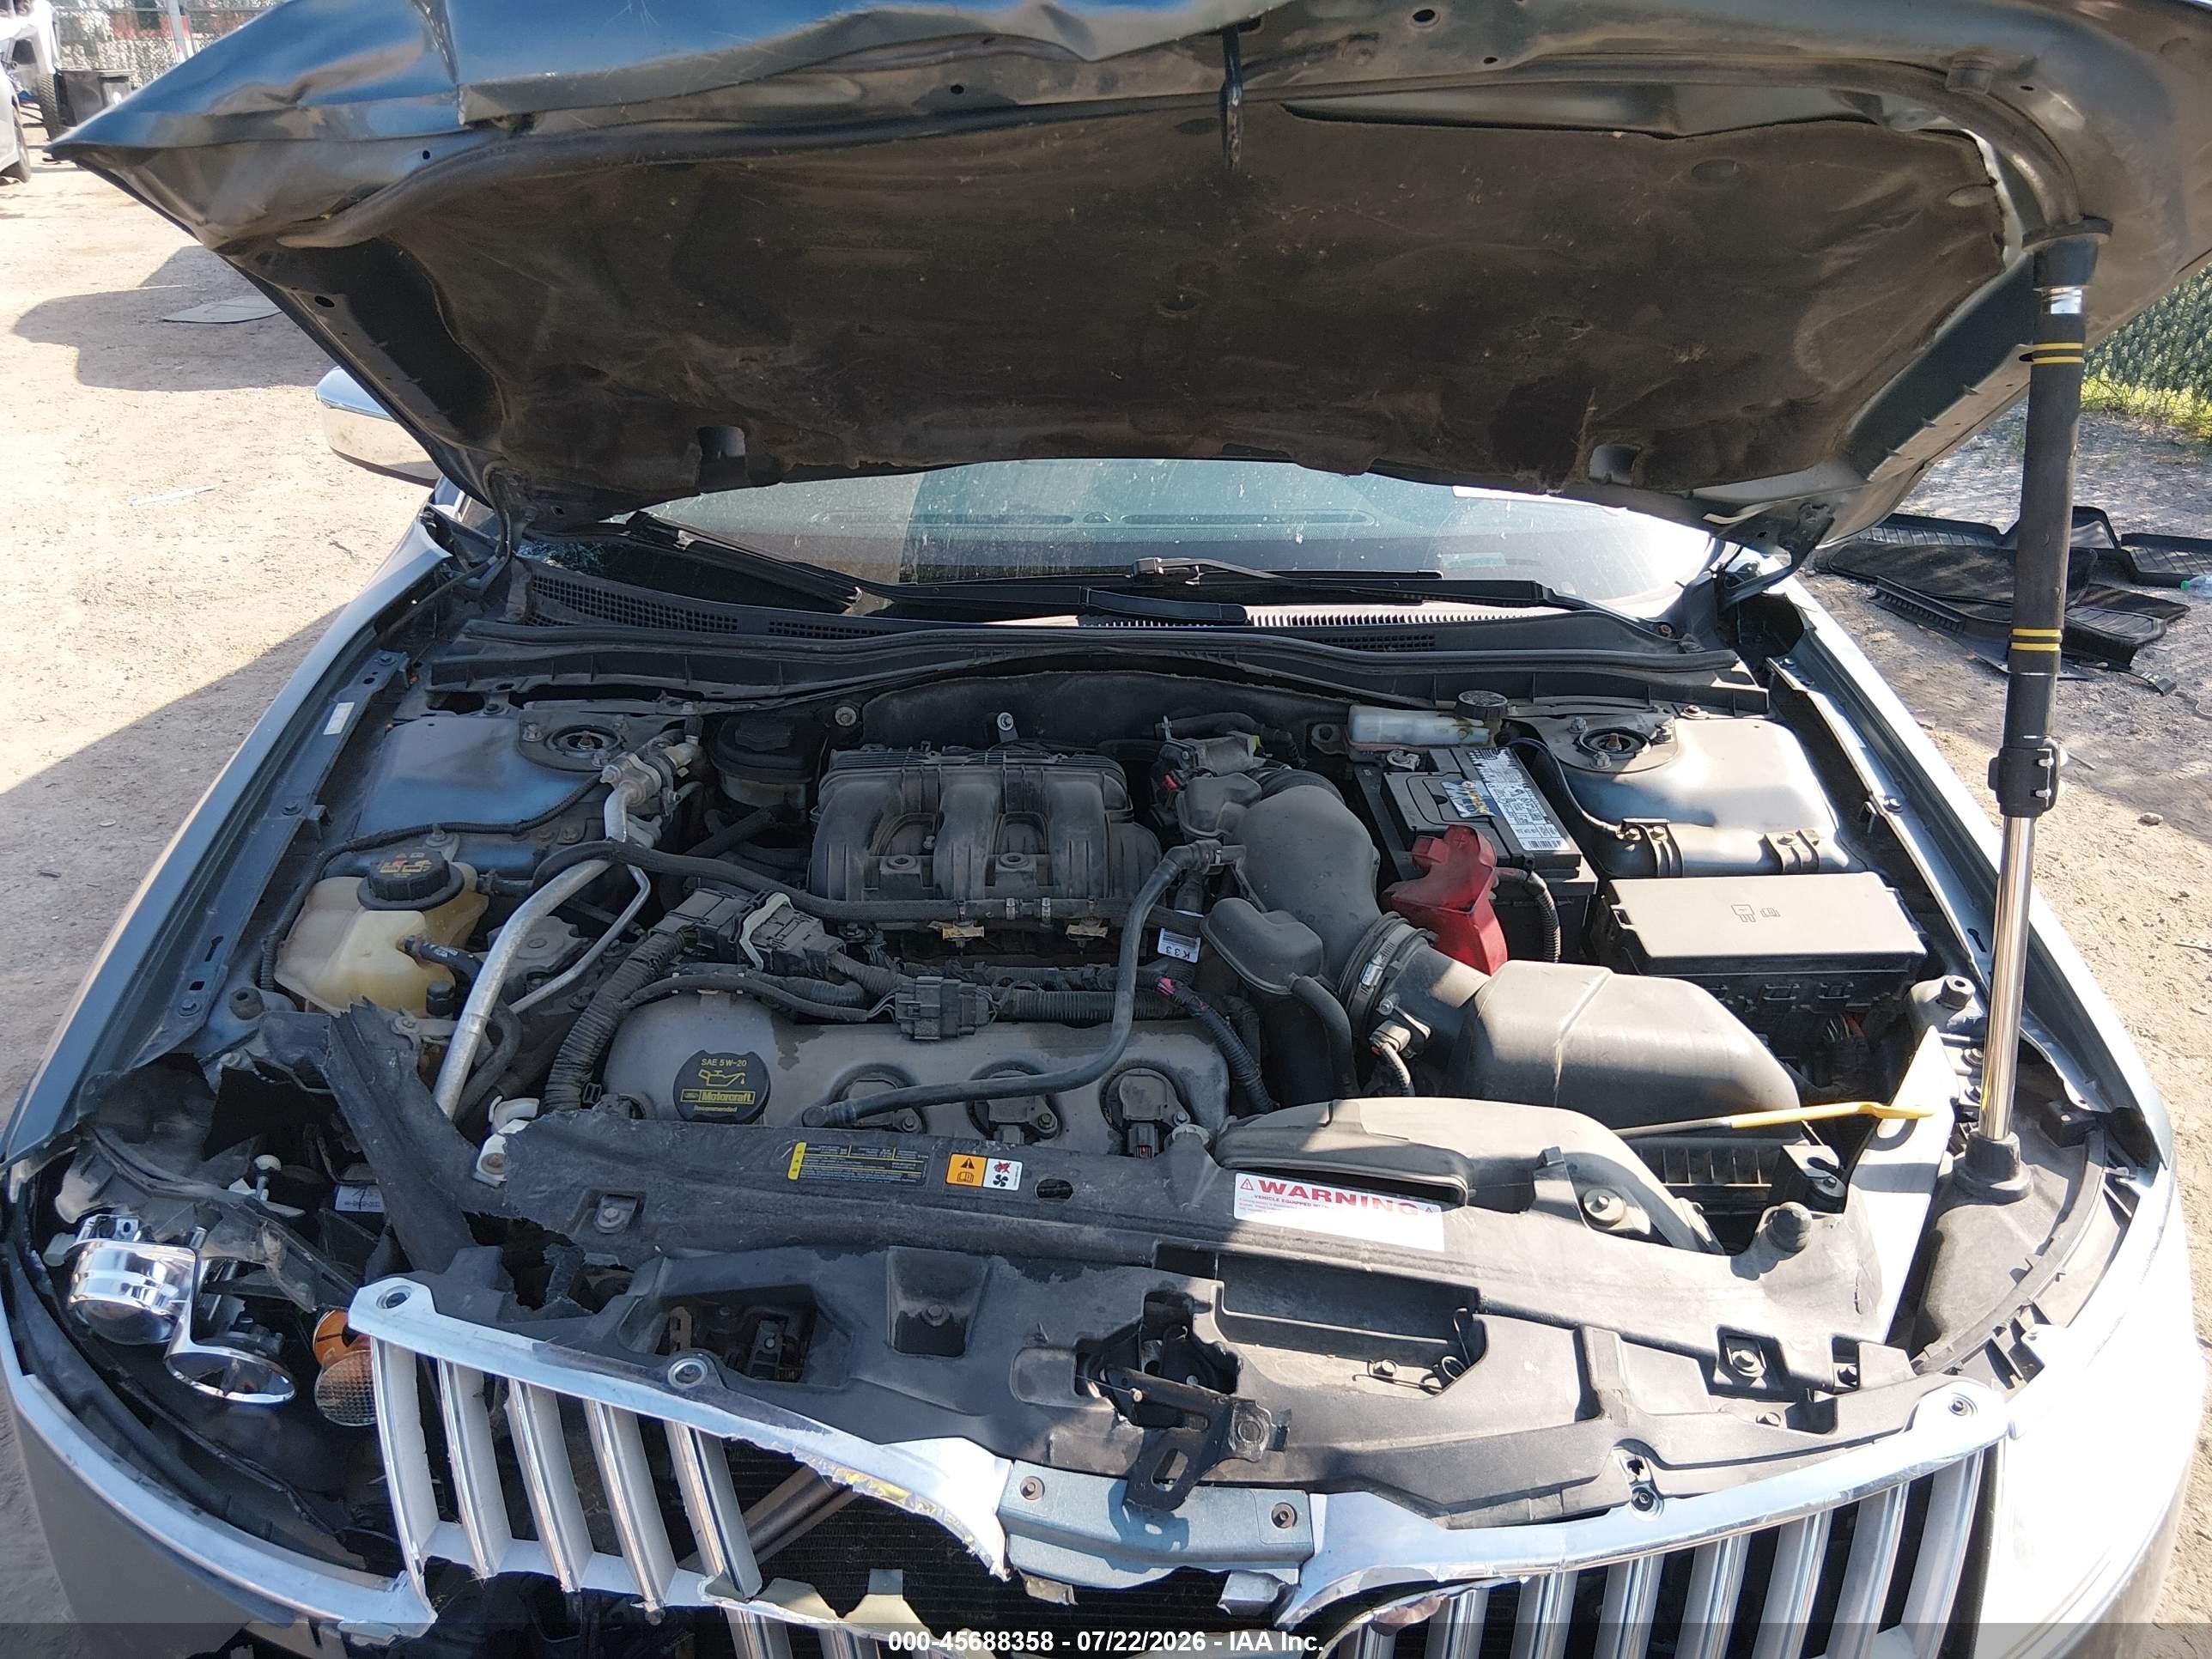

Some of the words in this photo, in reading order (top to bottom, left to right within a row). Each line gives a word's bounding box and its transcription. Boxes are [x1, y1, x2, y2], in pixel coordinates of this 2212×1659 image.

[719, 1059, 747, 1067] 5W-20
[702, 1091, 752, 1102] Motorcraft
[1257, 1179, 1420, 1216] WARNING
